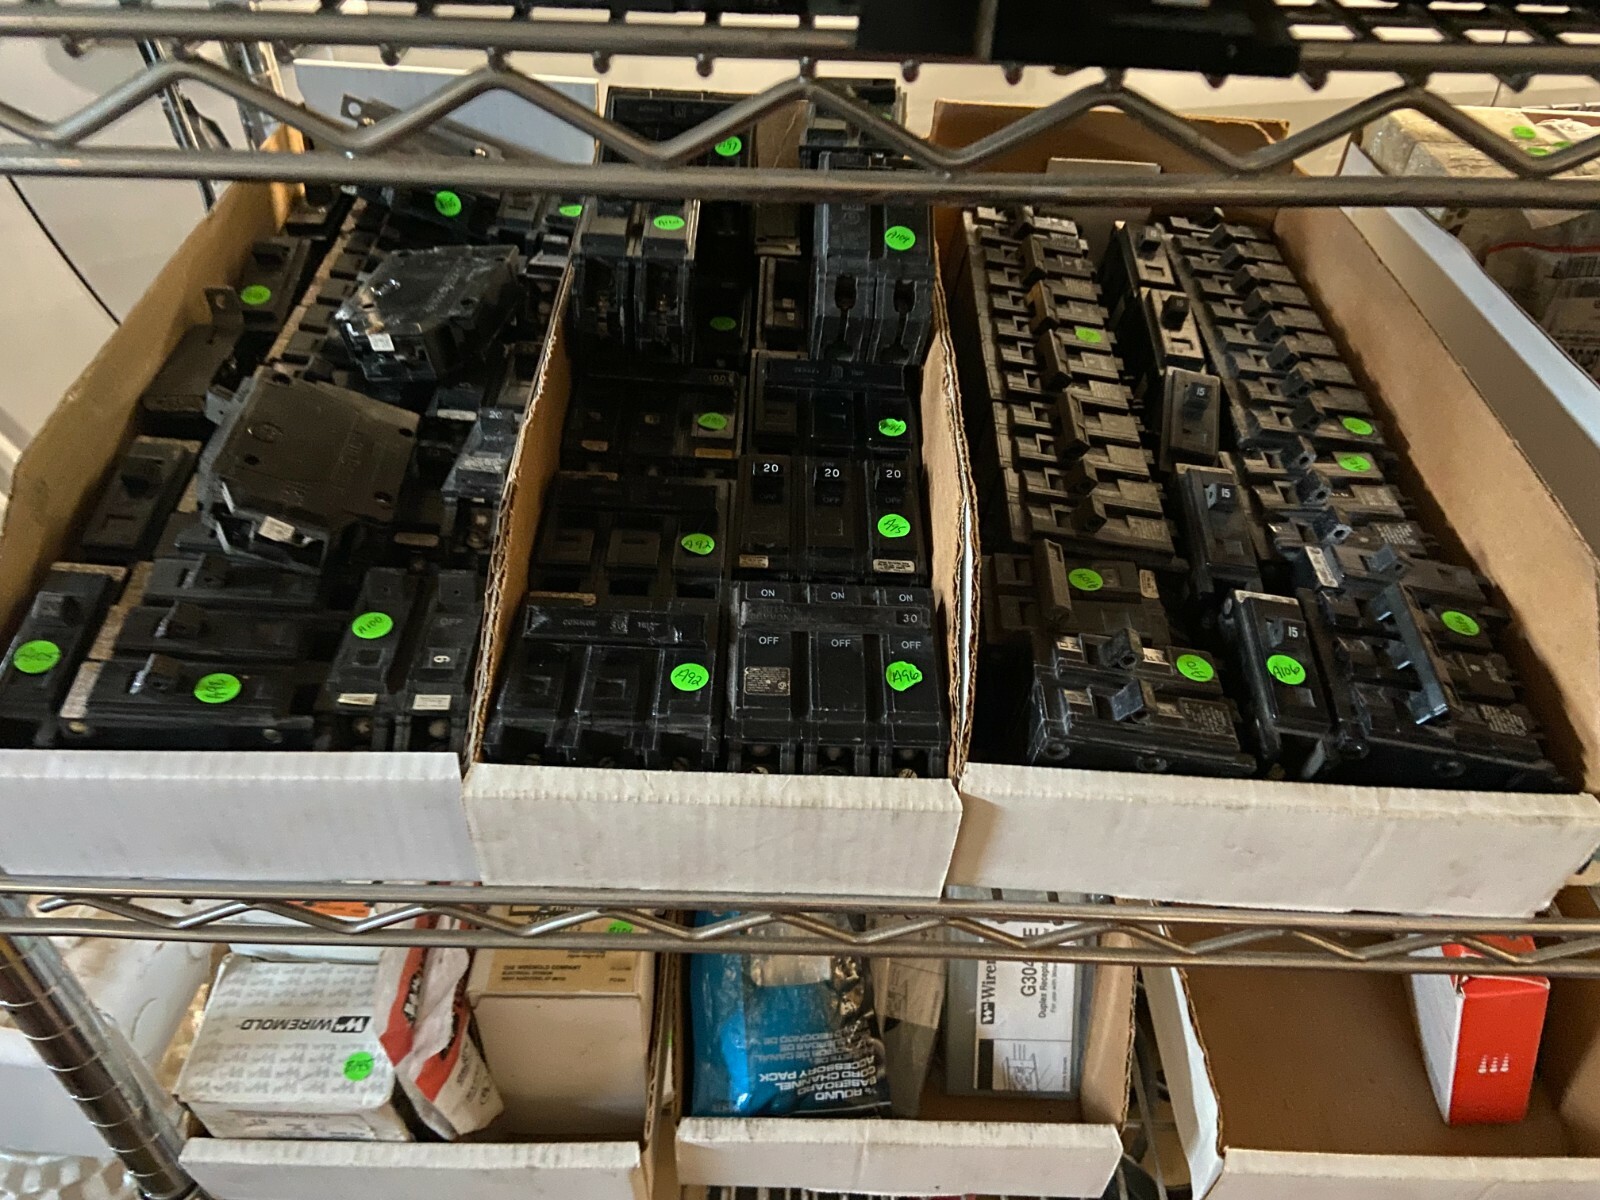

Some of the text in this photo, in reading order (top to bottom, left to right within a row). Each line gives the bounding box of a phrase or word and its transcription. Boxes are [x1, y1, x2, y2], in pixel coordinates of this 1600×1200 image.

[1196, 387, 1206, 397] 15
[763, 463, 779, 473] 20
[824, 468, 840, 478] 20
[885, 469, 902, 479] 20
[1221, 486, 1231, 498] 15
[761, 588, 775, 597] ON
[831, 591, 845, 600] ON
[899, 594, 914, 603] ON
[903, 614, 918, 623] 30
[1288, 626, 1299, 638] 15
[758, 636, 780, 646] OFF
[831, 639, 852, 649] OFF
[901, 640, 922, 650] OFF
[675, 667, 703, 685] A92
[1273, 664, 1300, 679] A106
[1020, 928, 1040, 997] G304E
[1038, 993, 1050, 1019] Duplex
[239, 1019, 333, 1031] WIREMOLD
[758, 1055, 876, 1082] ACCESSORY PACK
[774, 1065, 877, 1091] CORD CHANNEL
[796, 1076, 878, 1096] BASEBOARD
[814, 1087, 863, 1101] ROUND
